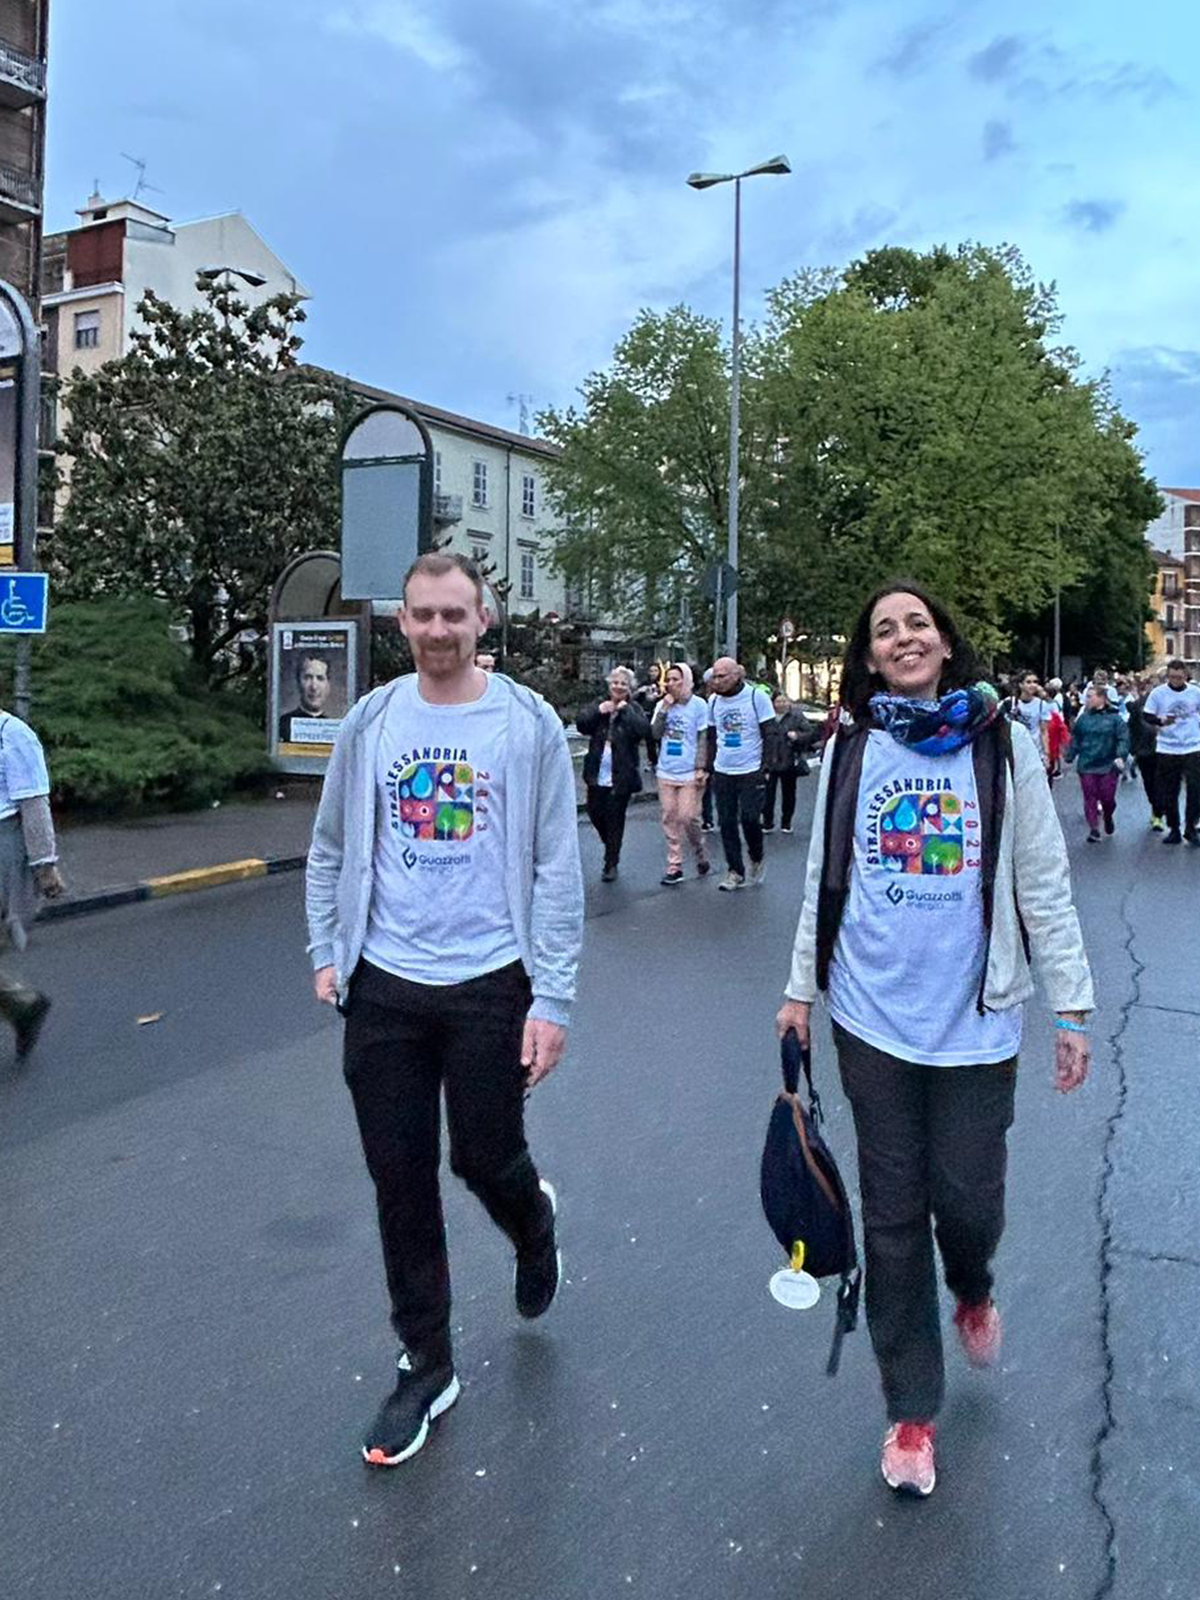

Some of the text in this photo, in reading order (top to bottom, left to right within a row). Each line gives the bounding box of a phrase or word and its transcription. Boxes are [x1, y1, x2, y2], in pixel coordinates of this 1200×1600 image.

[386, 747, 468, 829] STRALESSANDRIA
[475, 771, 490, 832] 2023
[866, 777, 952, 865] STRALESSANDRIA
[964, 800, 980, 868] 2023
